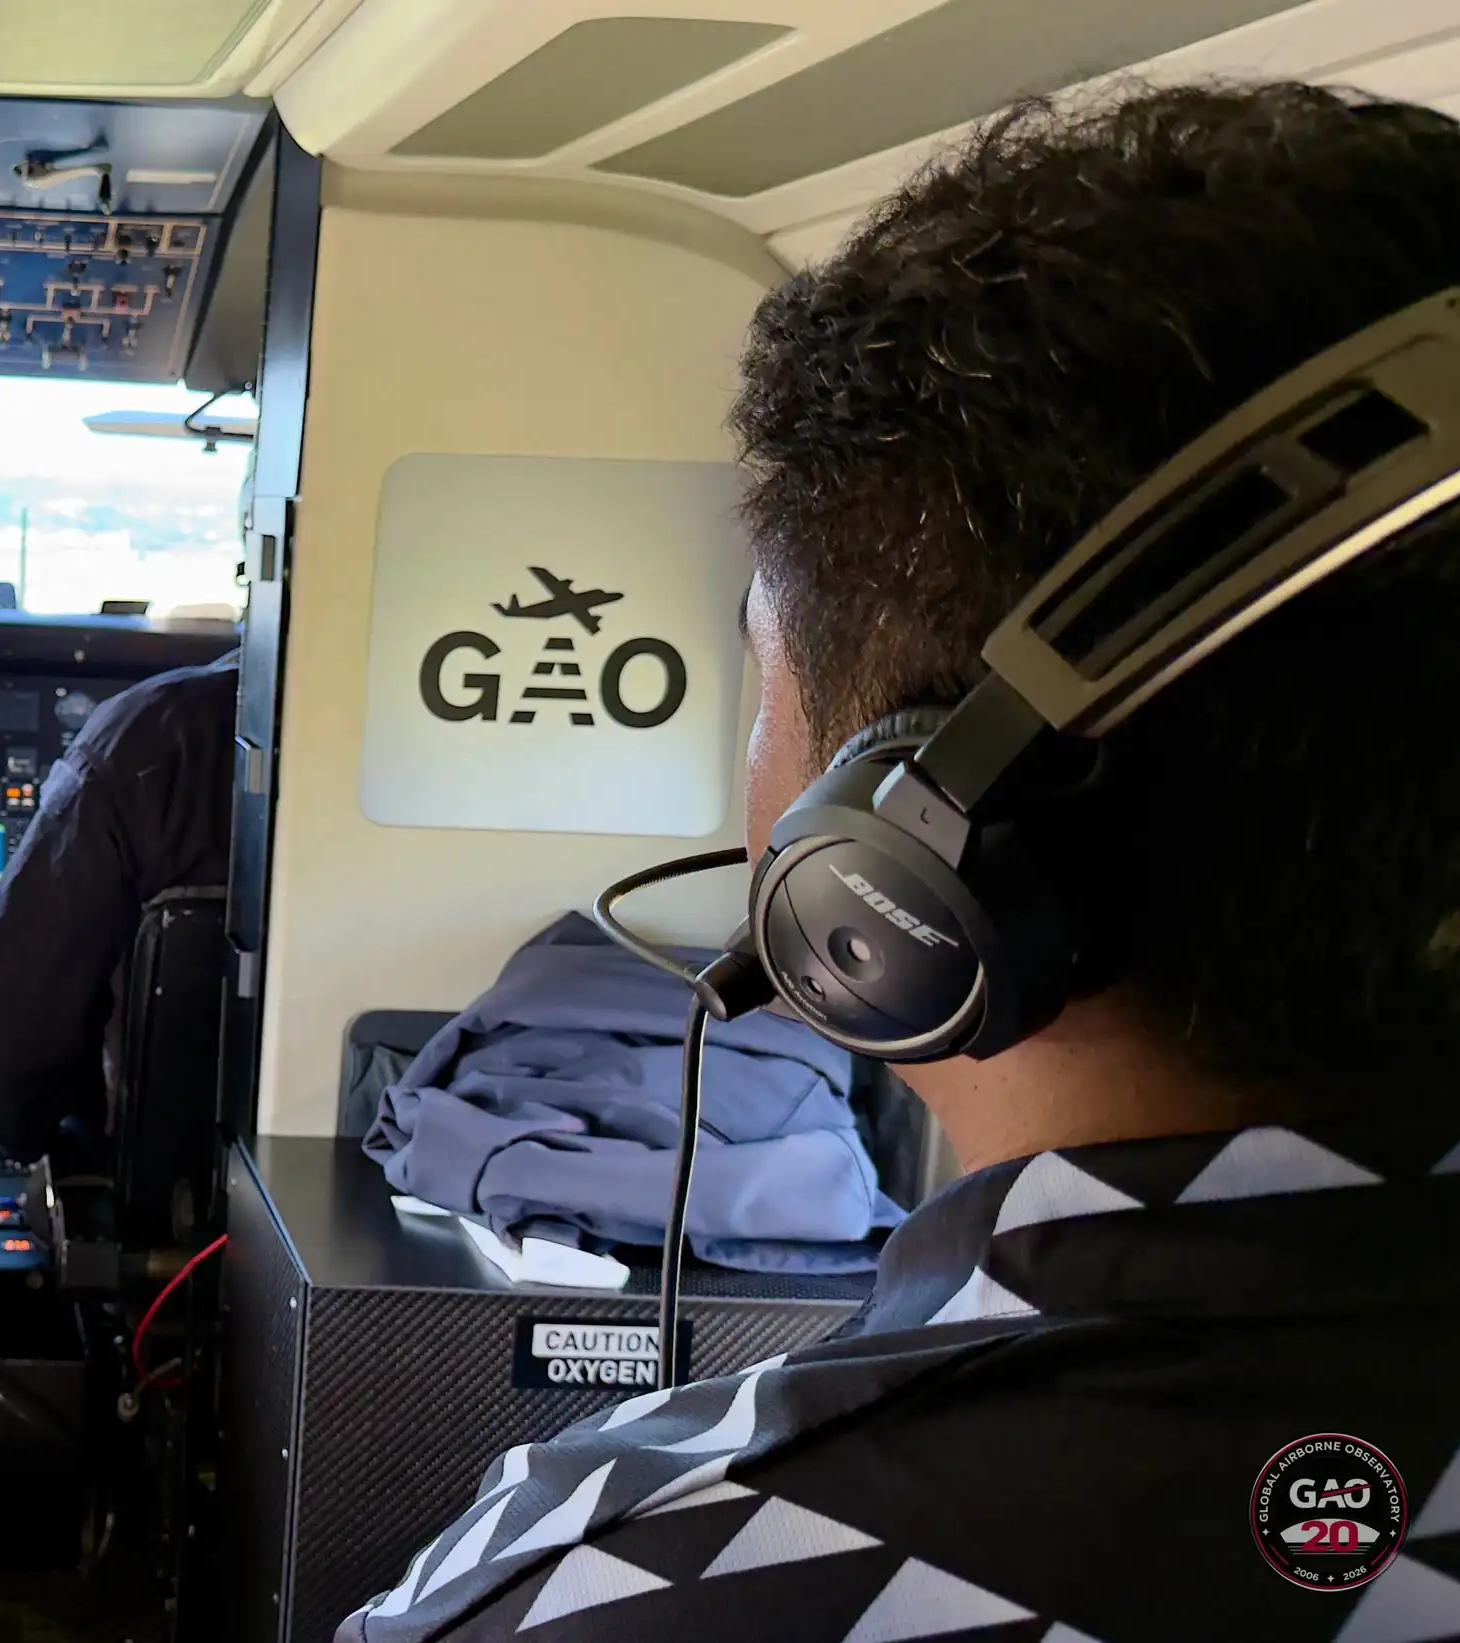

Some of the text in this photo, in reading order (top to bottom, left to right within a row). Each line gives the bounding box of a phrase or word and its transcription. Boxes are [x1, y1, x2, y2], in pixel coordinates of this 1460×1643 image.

[419, 630, 687, 728] GAO
[828, 864, 959, 948] BOSE
[547, 1358, 656, 1386] OXYGEN
